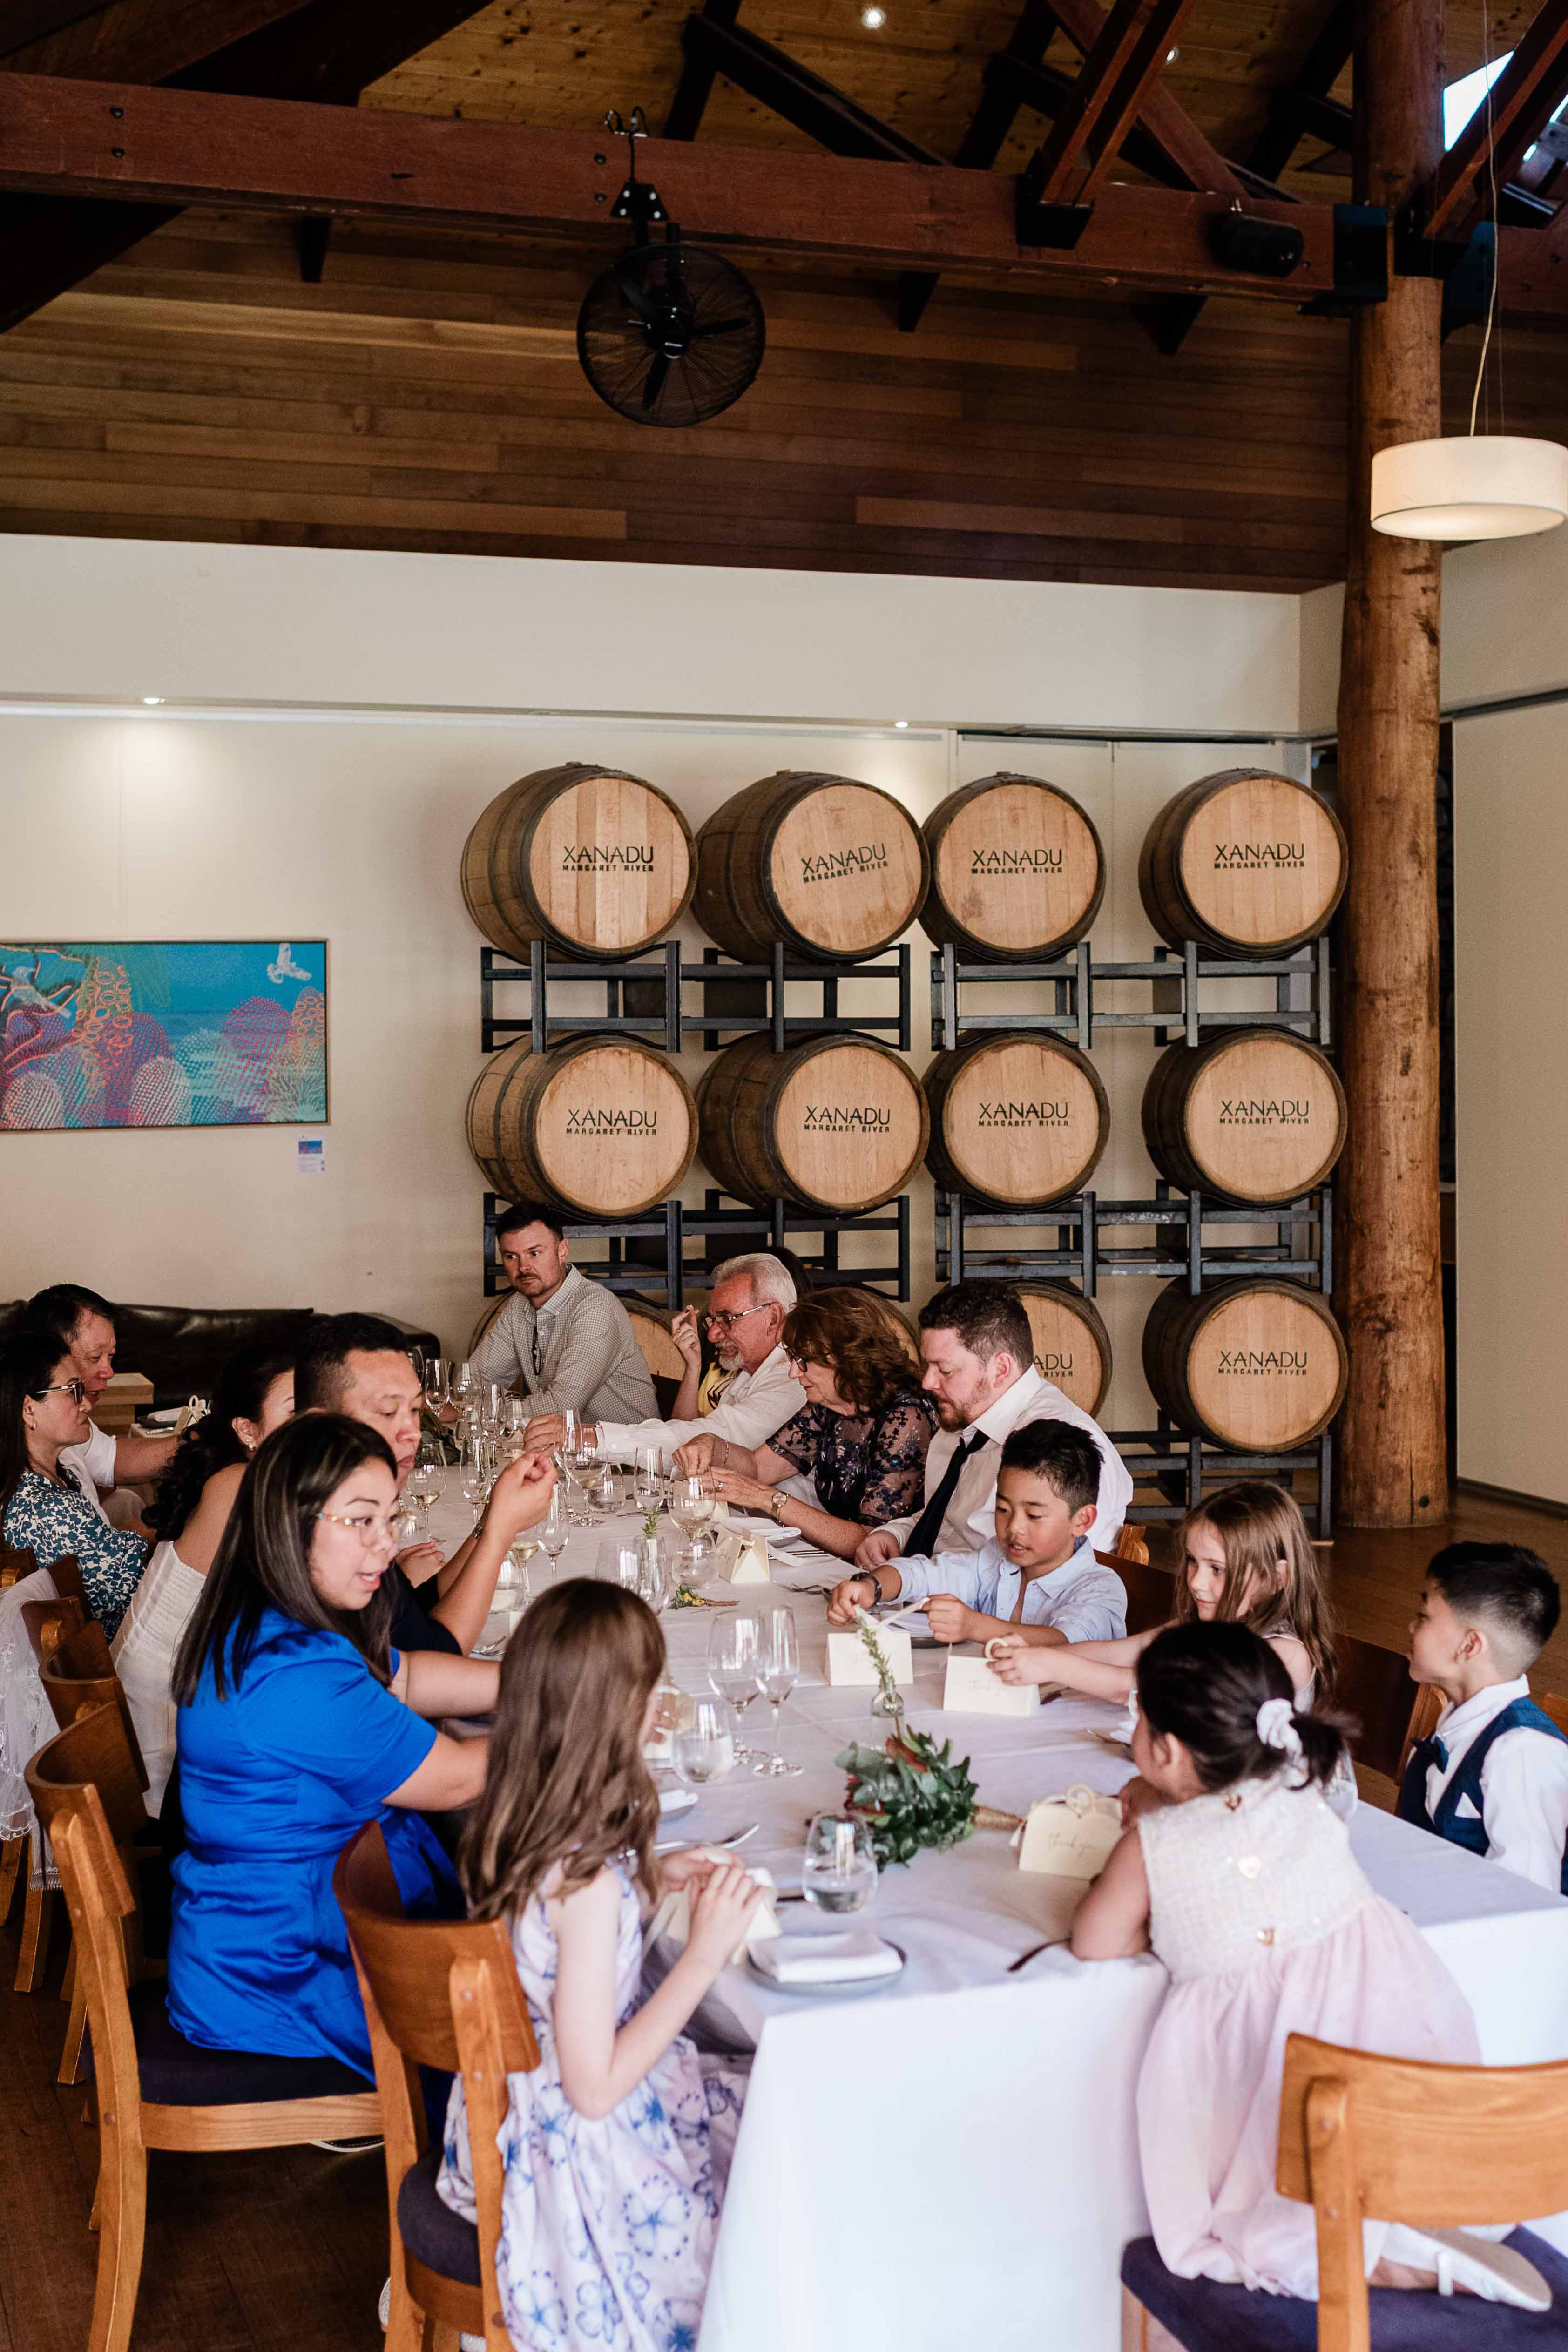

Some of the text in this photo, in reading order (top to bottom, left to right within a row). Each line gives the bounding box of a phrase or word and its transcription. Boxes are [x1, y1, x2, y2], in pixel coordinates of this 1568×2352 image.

[563, 846, 654, 864] XANADU
[801, 843, 885, 875] XANADU
[972, 849, 1062, 866] XANADU
[1215, 844, 1304, 861] XANADU
[803, 861, 888, 883] MARGARET RIVER
[805, 1106, 890, 1125] XANADU
[980, 1102, 1068, 1118] XANADU
[1221, 1100, 1309, 1117] XANADU
[567, 1109, 657, 1127] XANADU
[1034, 1353, 1073, 1370] ADU
[1220, 1351, 1307, 1368] XANADU
